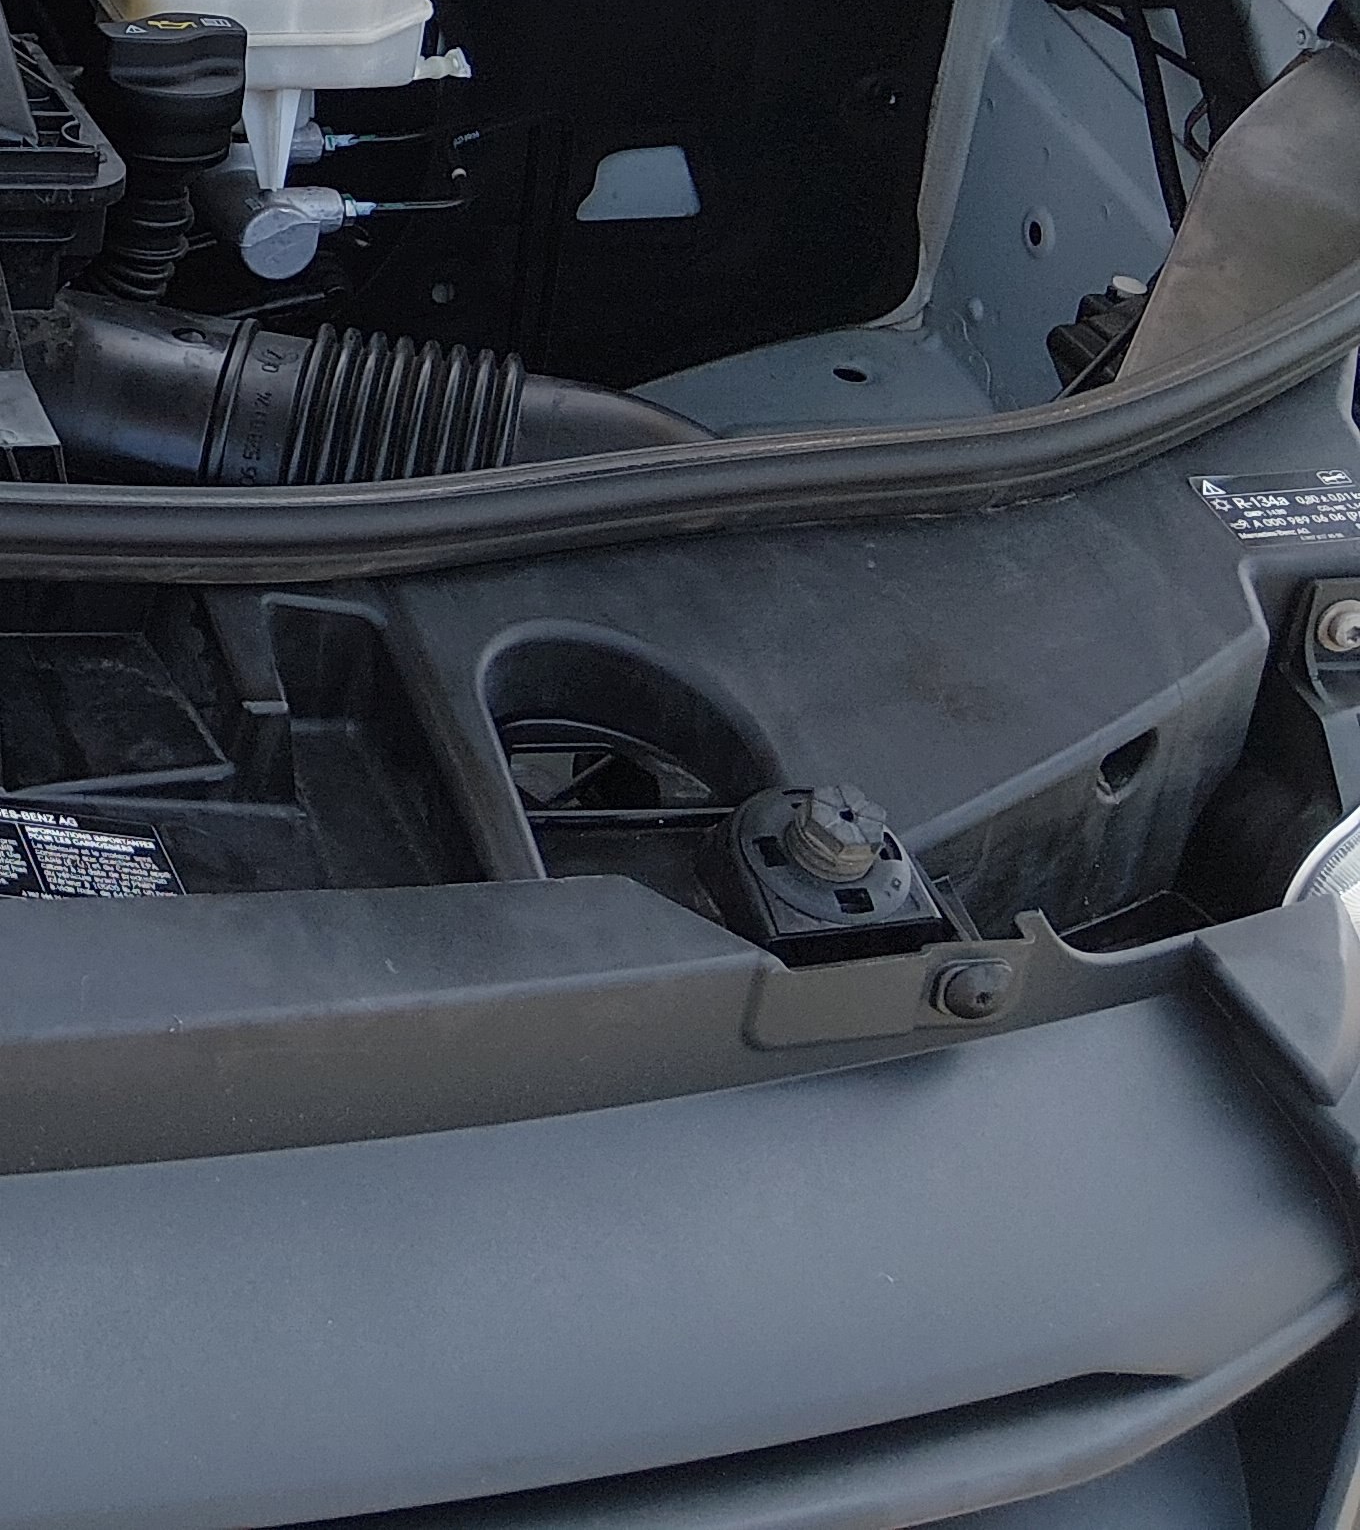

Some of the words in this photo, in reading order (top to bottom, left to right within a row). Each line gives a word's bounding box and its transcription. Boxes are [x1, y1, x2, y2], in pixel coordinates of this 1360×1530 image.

[1232, 496, 1289, 509] R-134a
[1252, 520, 1264, 529] A
[1262, 518, 1287, 527] 000
[1311, 514, 1329, 523] 06
[1329, 513, 1346, 521] 06
[59, 815, 78, 827] AG
[25, 826, 92, 840] INFORMATIONS
